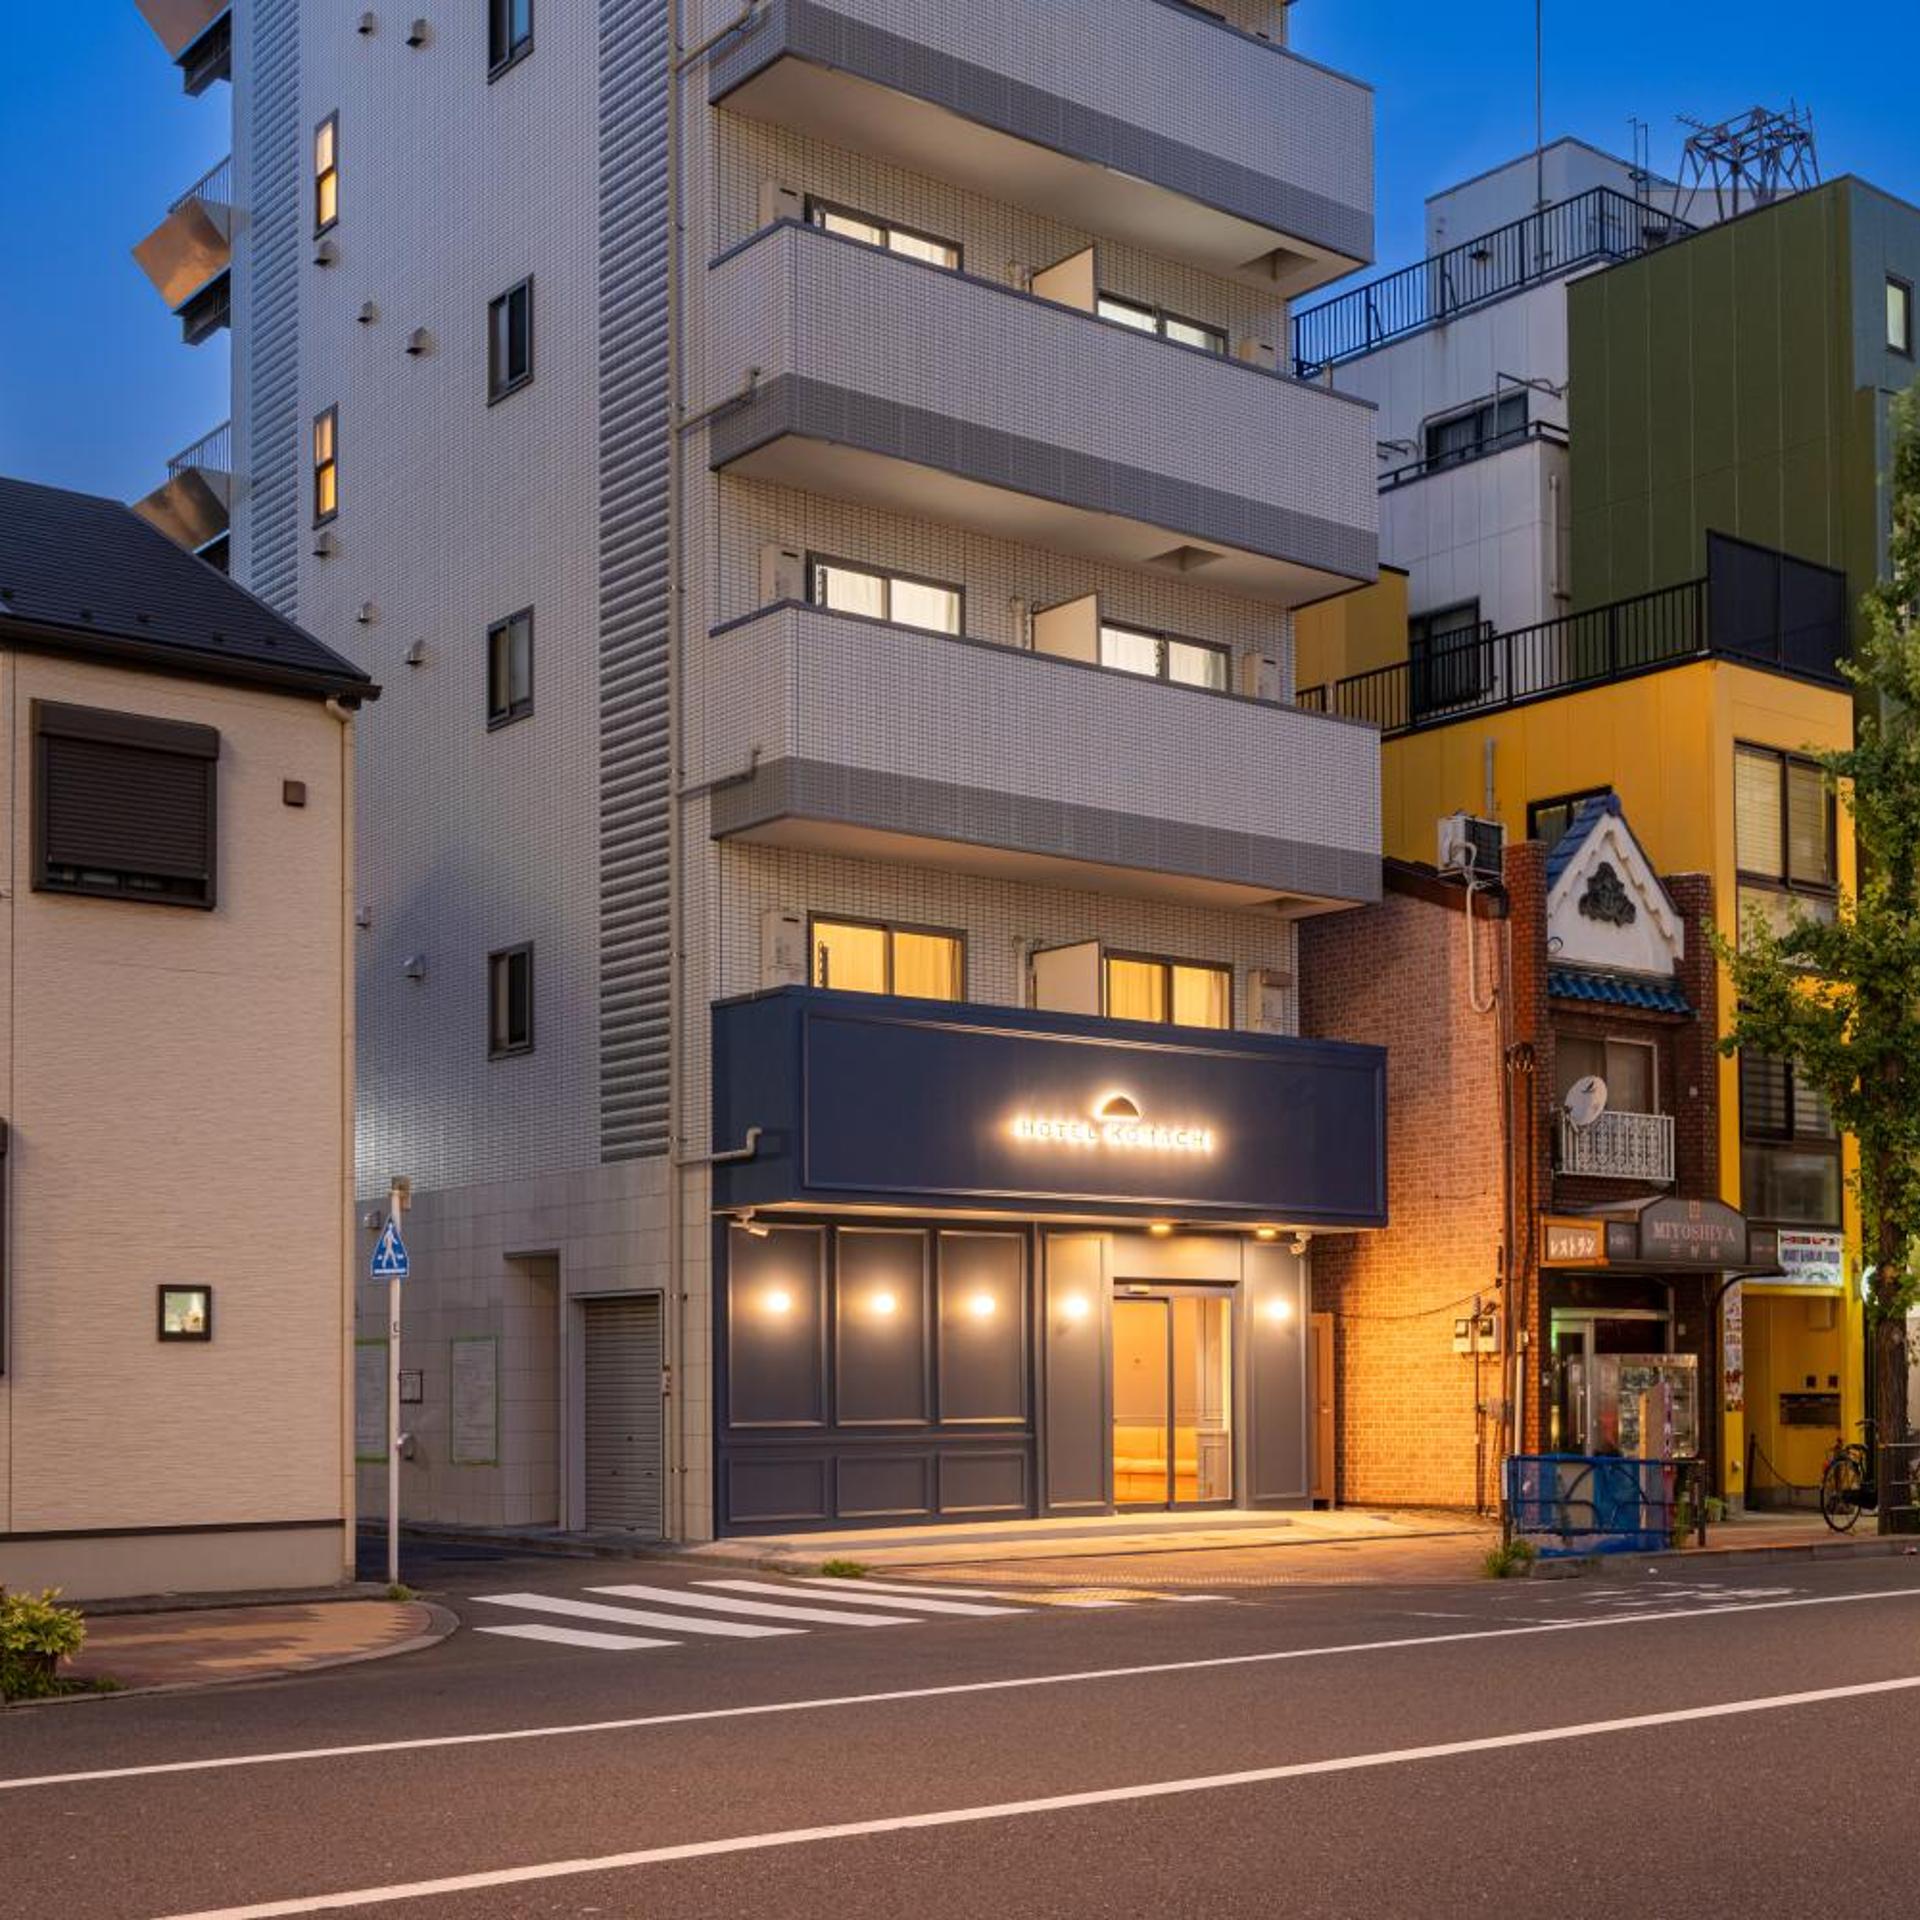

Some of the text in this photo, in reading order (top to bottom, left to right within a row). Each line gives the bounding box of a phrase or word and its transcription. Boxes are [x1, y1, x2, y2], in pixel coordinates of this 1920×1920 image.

[1017, 1119, 1099, 1144] HOTEL
[1550, 1236, 1595, 1258] レストラン
